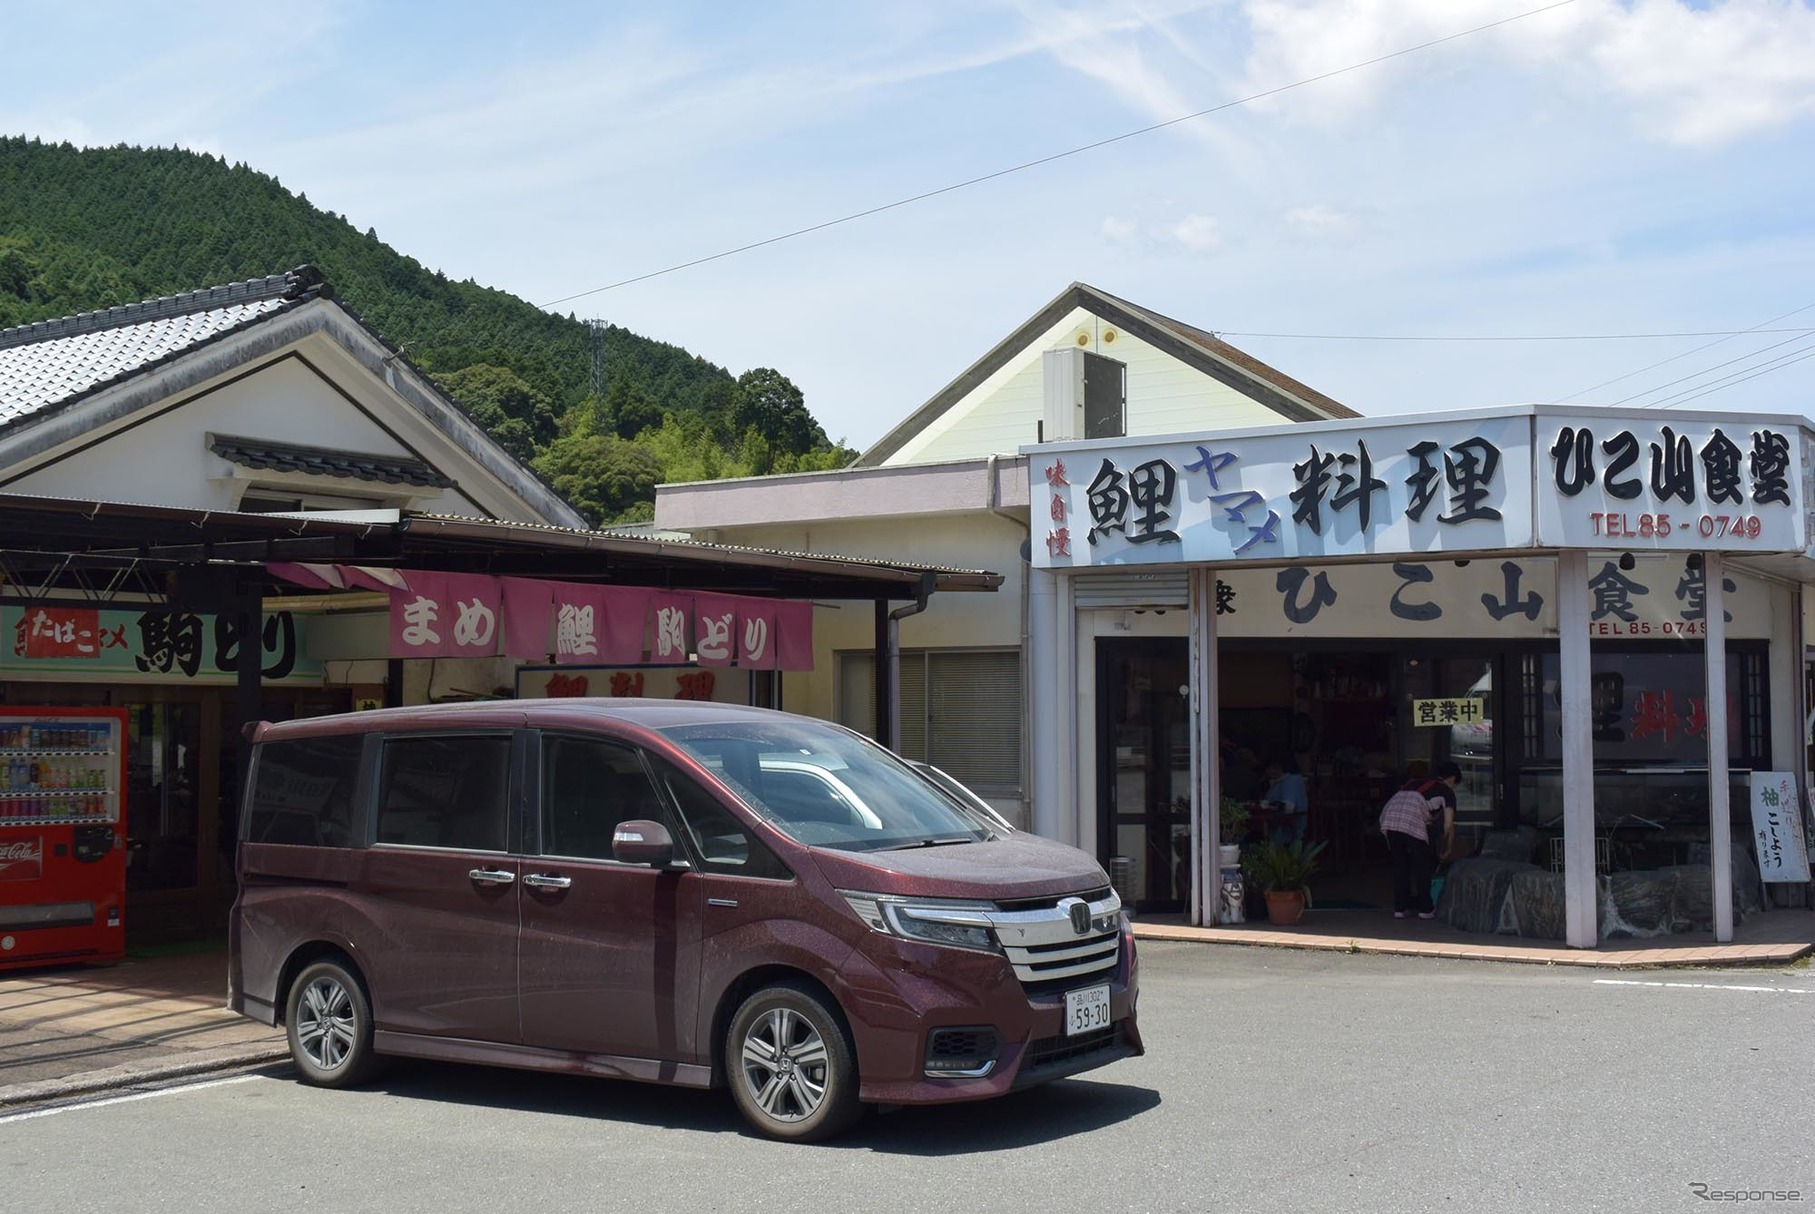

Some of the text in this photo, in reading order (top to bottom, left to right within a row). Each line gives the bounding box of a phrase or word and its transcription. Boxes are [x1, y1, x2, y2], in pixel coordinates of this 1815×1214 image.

[1550, 425, 1791, 507] ひこ山食堂
[1046, 458, 1071, 557] 味自慢
[32, 610, 95, 653] たばこ
[1418, 700, 1478, 723] 営業中
[1076, 1002, 1108, 1030] 59-30
